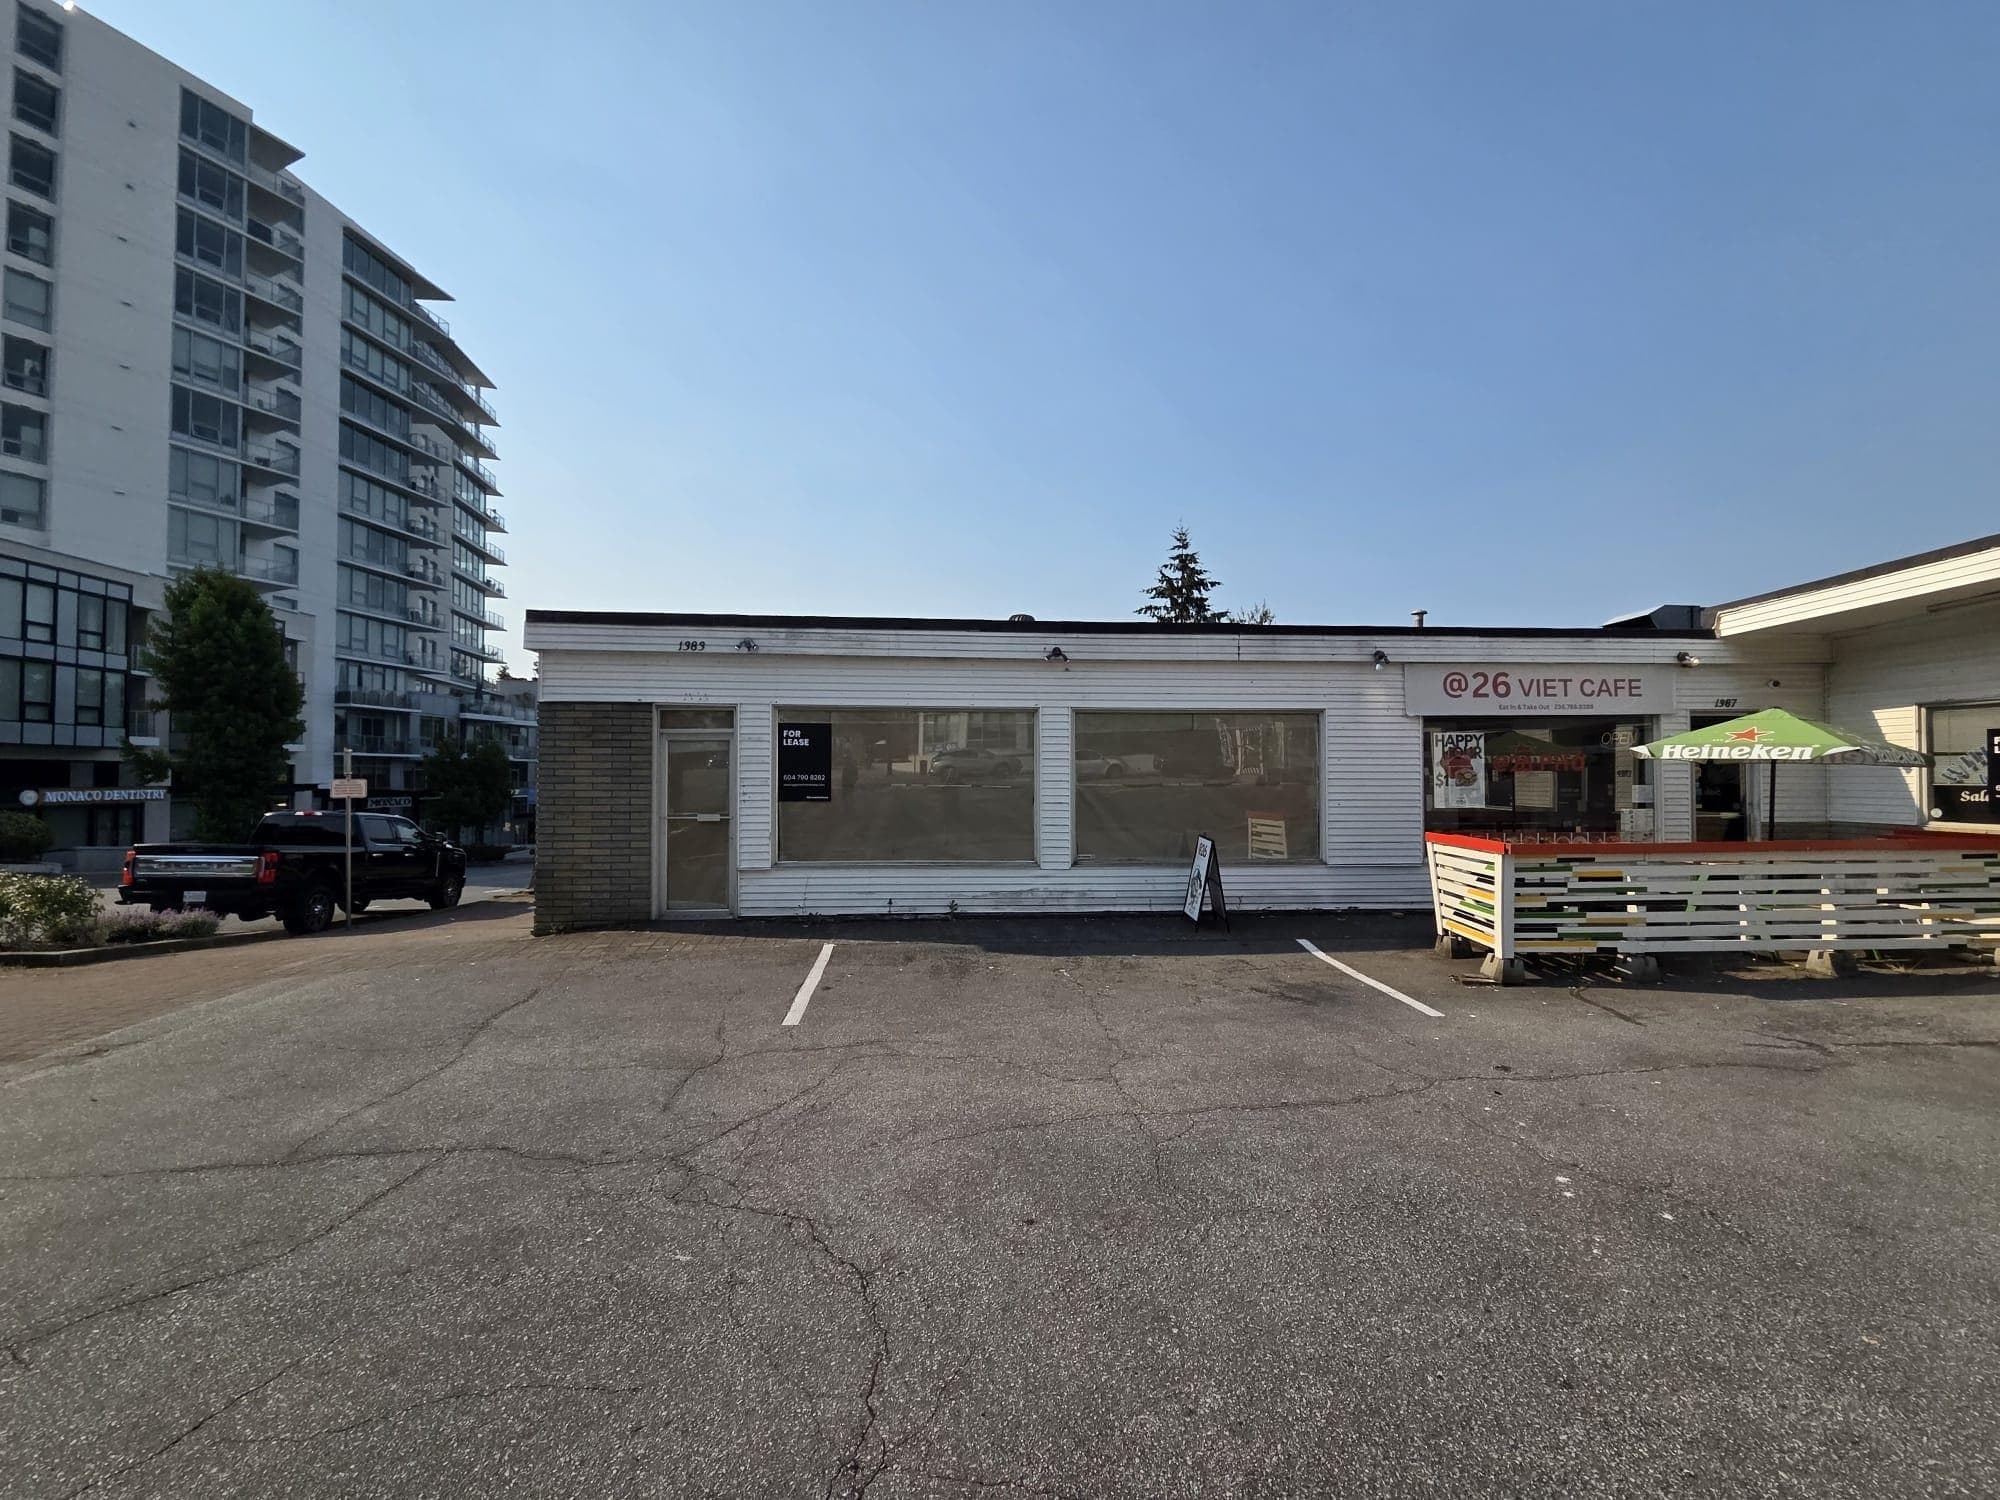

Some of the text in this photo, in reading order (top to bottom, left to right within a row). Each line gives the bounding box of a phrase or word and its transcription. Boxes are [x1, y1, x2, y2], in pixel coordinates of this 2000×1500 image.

[1442, 671, 1643, 699] @26 VIET CAFE
[1714, 698, 1738, 708] 1987
[783, 730, 801, 738] FOR
[1601, 730, 1638, 747] OPEN
[783, 738, 810, 746] LEASE
[1435, 734, 1483, 751] HAPPY
[1660, 743, 1815, 760] Heineken
[45, 789, 167, 803] MONACO DENTISTRY
